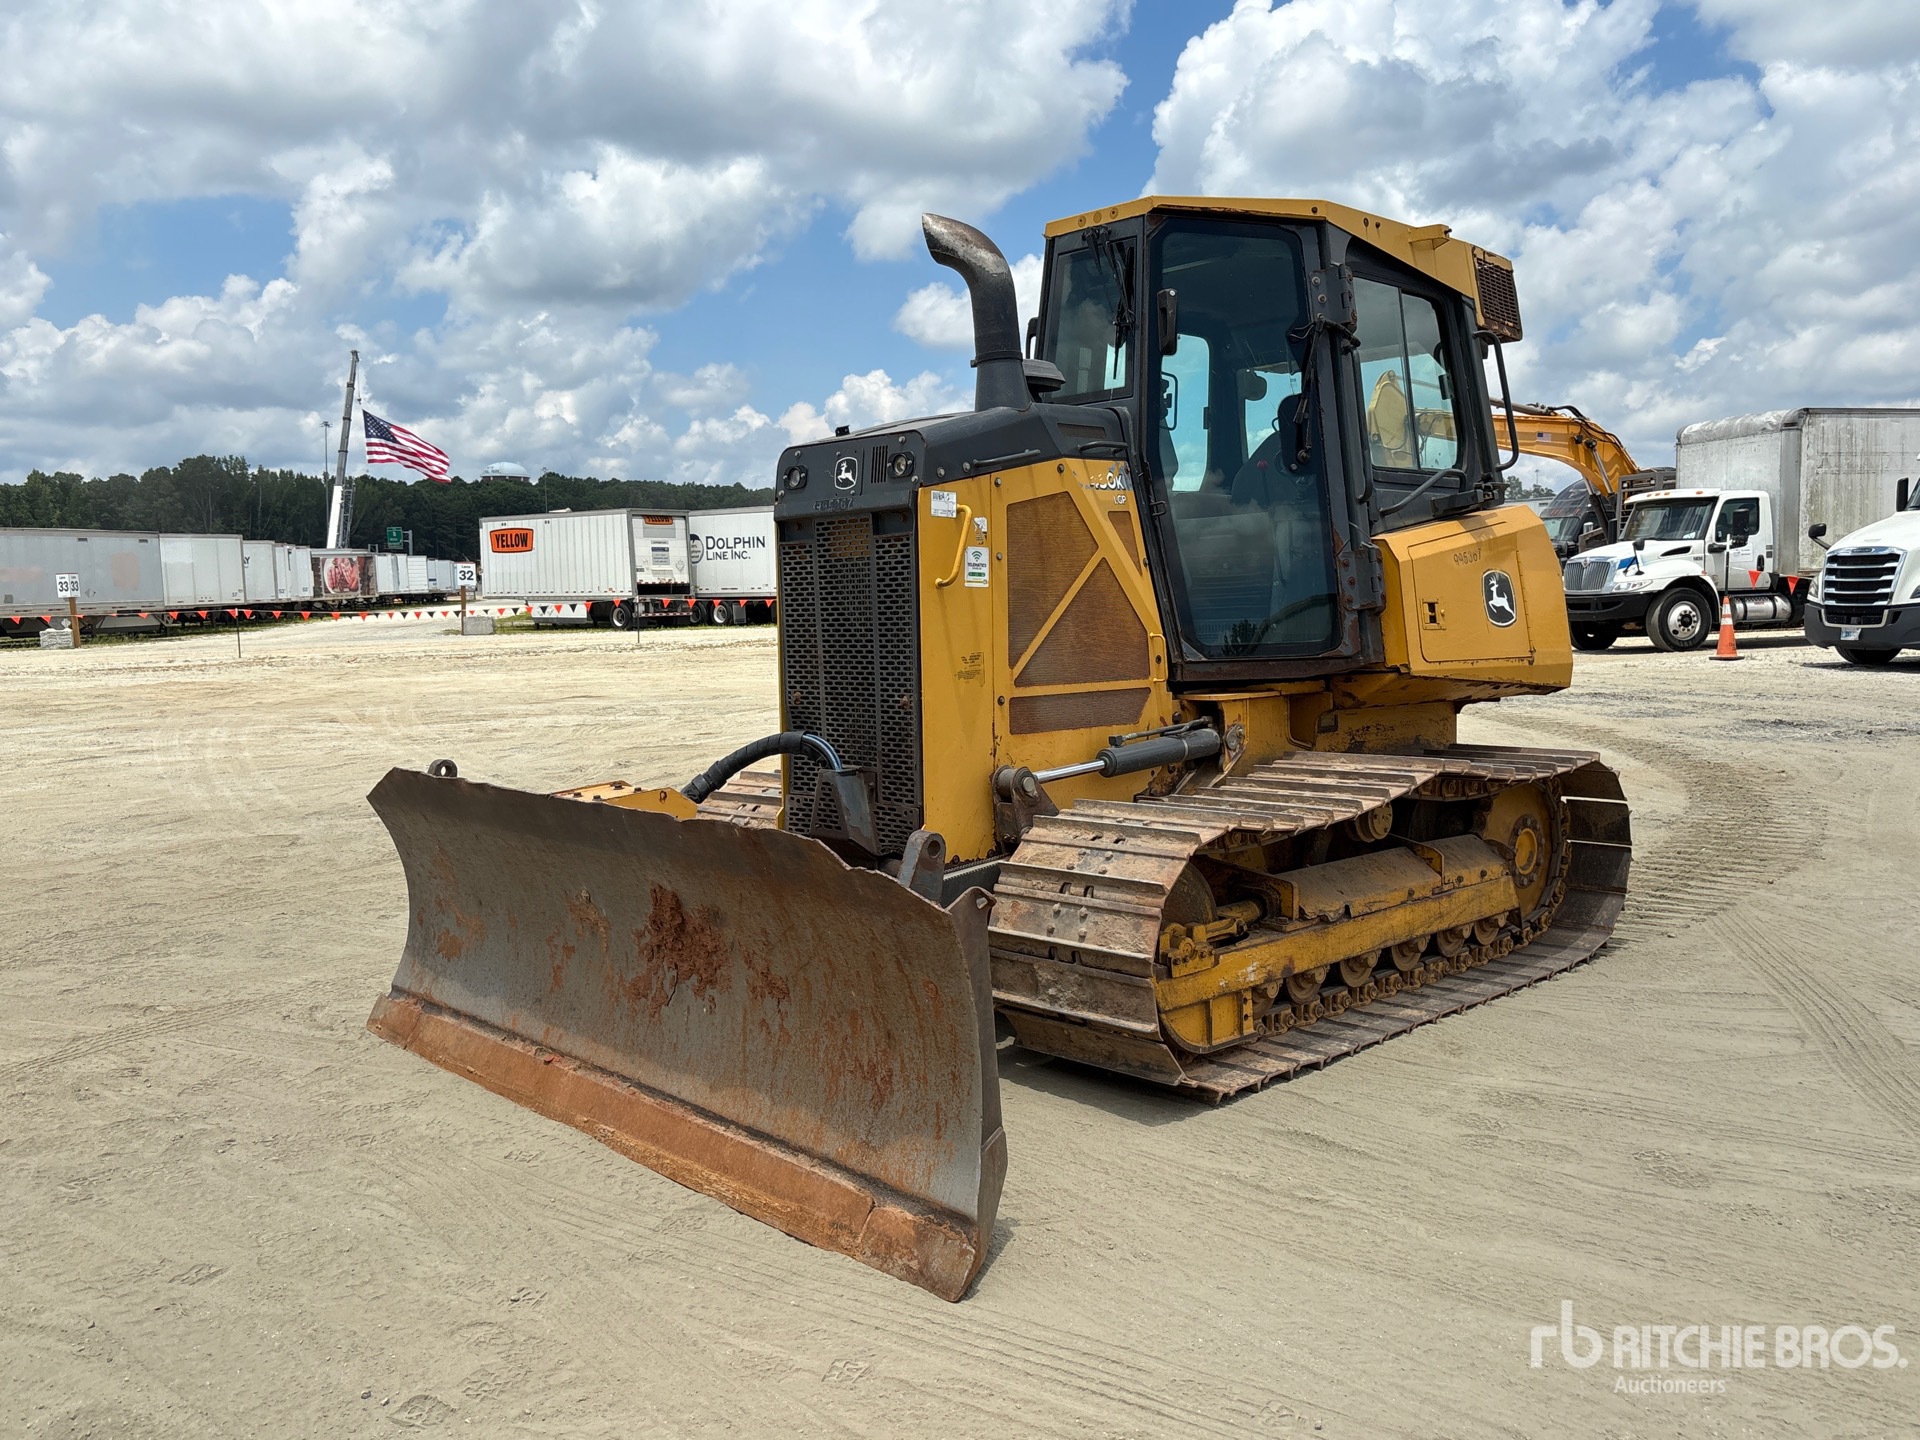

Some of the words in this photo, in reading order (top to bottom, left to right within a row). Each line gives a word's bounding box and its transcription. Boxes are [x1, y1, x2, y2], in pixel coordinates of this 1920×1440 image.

[495, 533, 529, 548] YELLOW
[705, 535, 766, 550] DOLPHIN
[706, 551, 729, 560] LINE
[731, 549, 751, 560] INC.
[459, 570, 474, 581] 32
[58, 581, 69, 592] 33
[70, 581, 79, 592] 33
